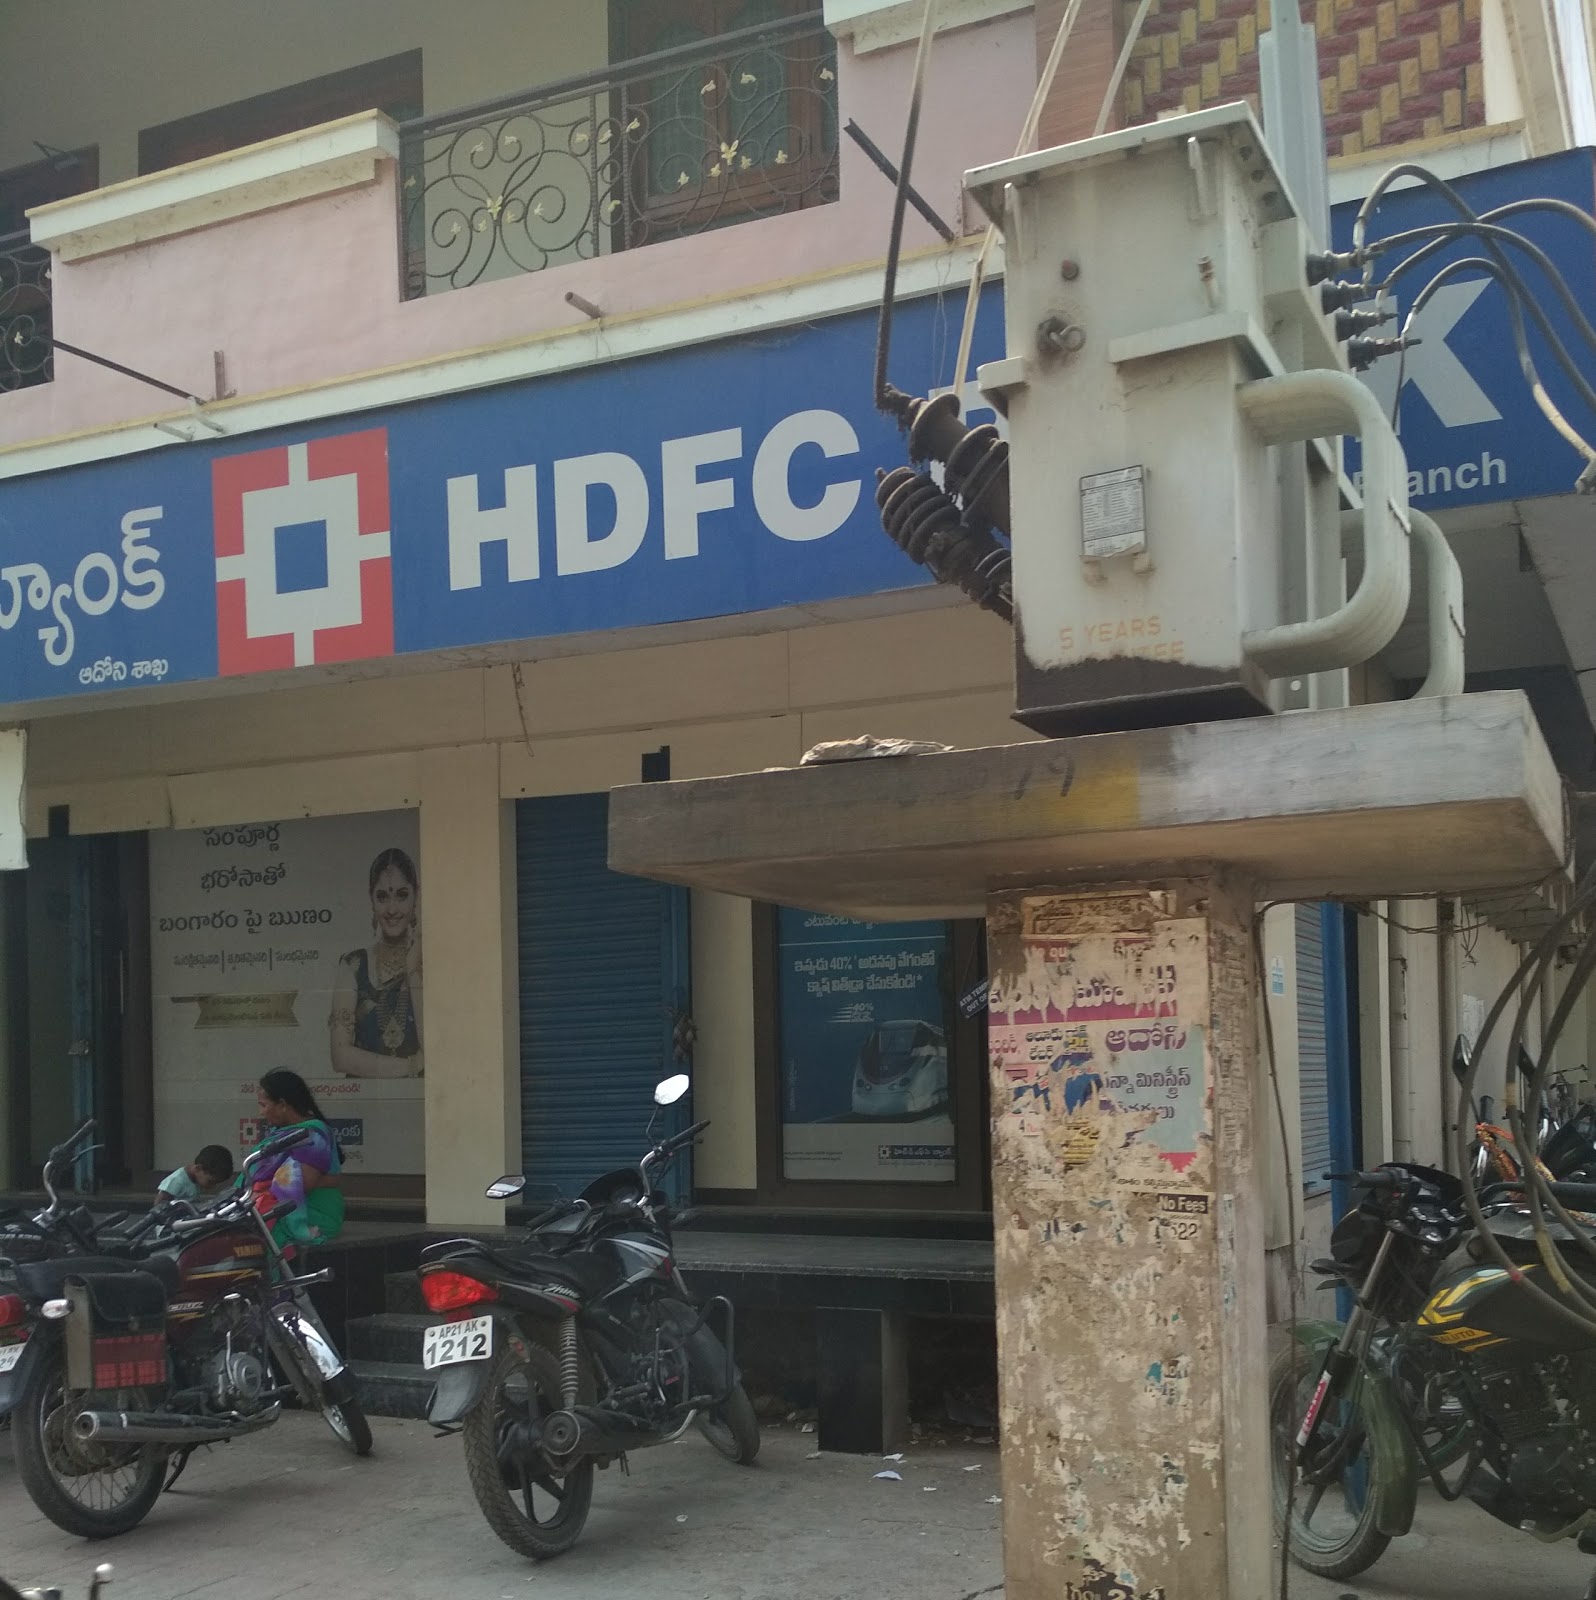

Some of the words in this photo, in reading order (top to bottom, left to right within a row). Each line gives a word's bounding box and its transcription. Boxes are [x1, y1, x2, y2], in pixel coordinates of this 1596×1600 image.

[1354, 451, 1507, 500] anch
[447, 409, 862, 591] HDFC
[1058, 627, 1076, 651] 5
[1083, 615, 1163, 645] YEARS
[79, 657, 127, 685] ఆదోని
[131, 658, 169, 682] శాఖ
[203, 823, 281, 852] సంపూర్ణ
[201, 863, 286, 893] భరోసాతో
[160, 910, 238, 932] బంగారం
[244, 909, 262, 933] పై
[960, 994, 972, 1008] ATM
[966, 999, 979, 1012] OUT
[1159, 1195, 1176, 1210] No
[1177, 1196, 1207, 1212] Fees
[439, 1323, 462, 1340] AP21
[463, 1319, 479, 1334] AK
[426, 1332, 488, 1366] 1212
